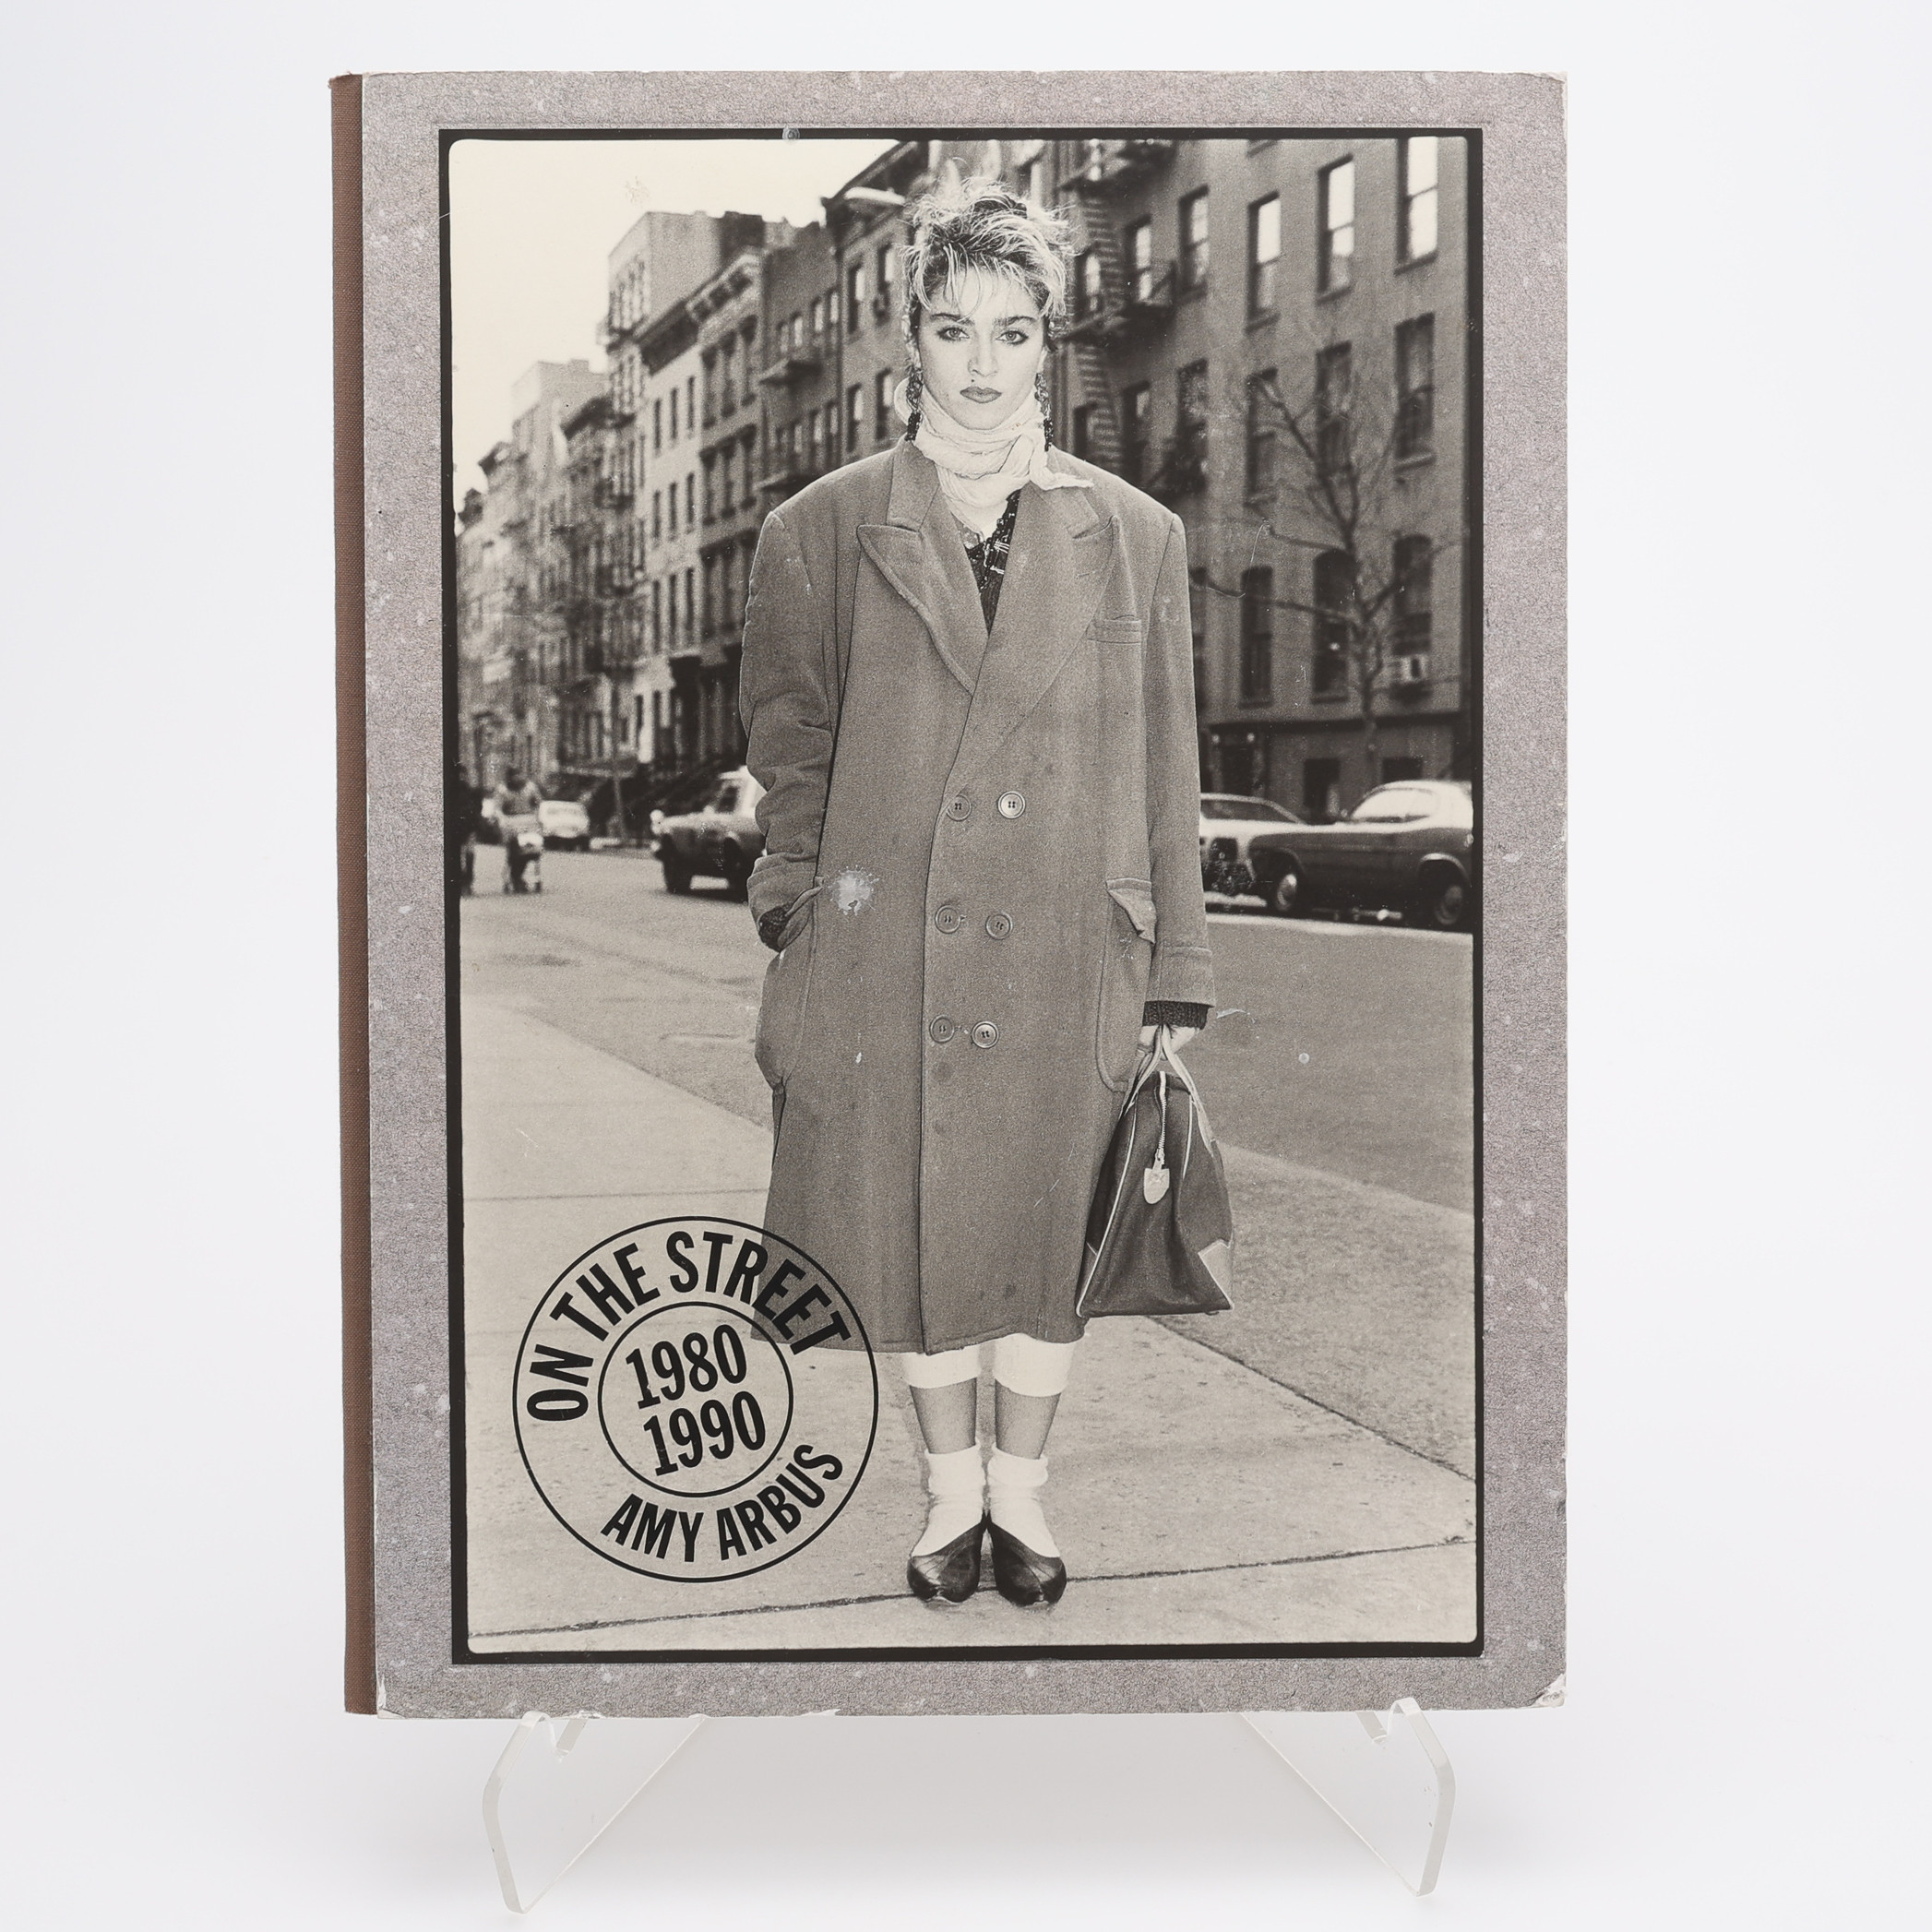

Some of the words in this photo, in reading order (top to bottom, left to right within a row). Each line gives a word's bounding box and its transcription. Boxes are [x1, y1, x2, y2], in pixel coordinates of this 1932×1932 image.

[549, 1243, 661, 1342] THE
[666, 1231, 852, 1354] STREET
[527, 1343, 594, 1421] ON
[626, 1324, 747, 1409] 1980
[643, 1391, 766, 1476] 1990
[601, 1494, 704, 1562] AMY
[716, 1445, 843, 1561] ARBUS
